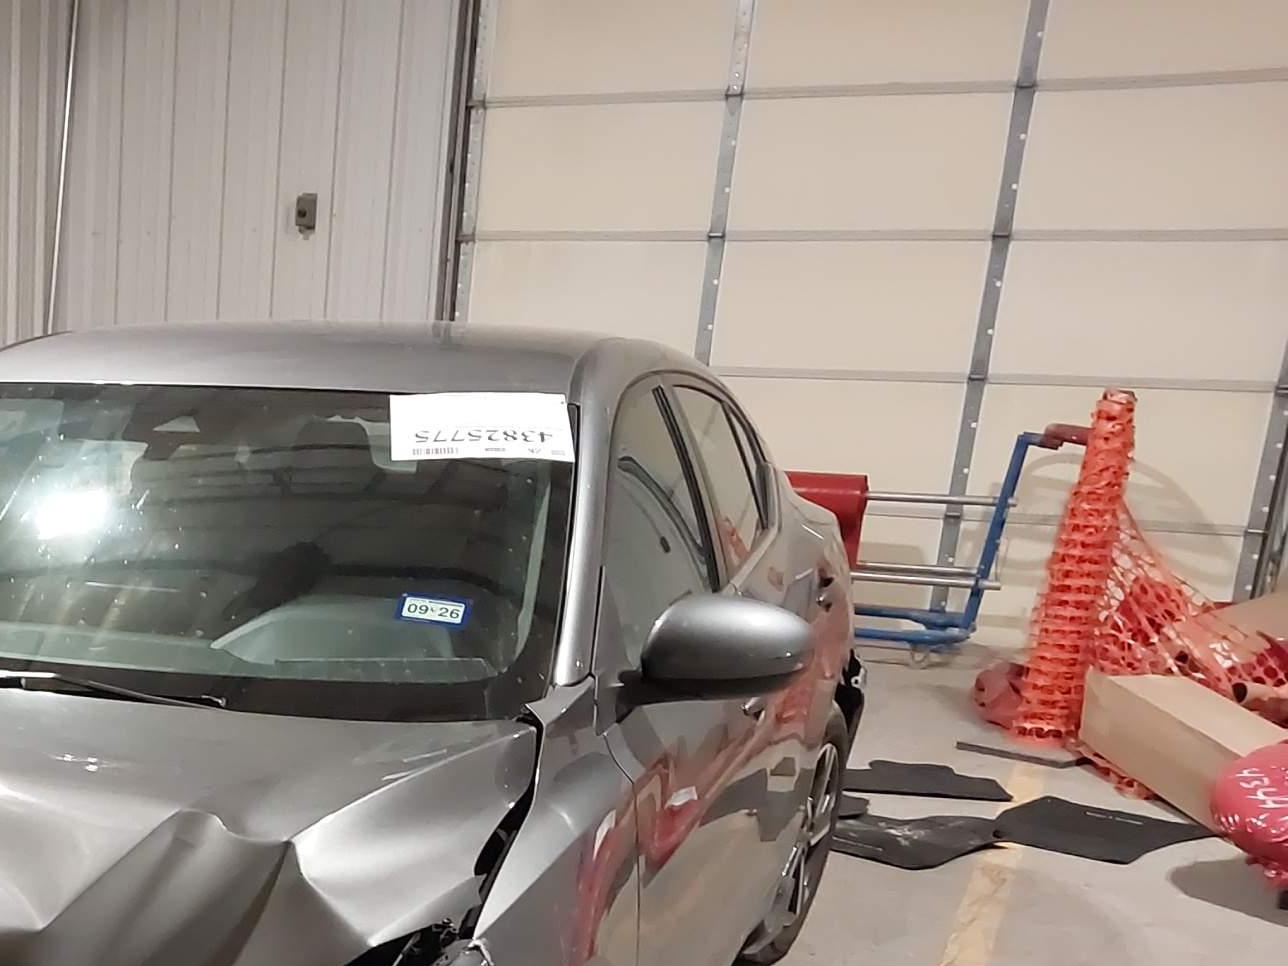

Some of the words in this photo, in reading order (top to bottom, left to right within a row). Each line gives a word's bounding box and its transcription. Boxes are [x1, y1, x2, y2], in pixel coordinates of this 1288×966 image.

[415, 429, 553, 443] 43825775
[407, 603, 429, 615] 09
[438, 606, 461, 619] 26
